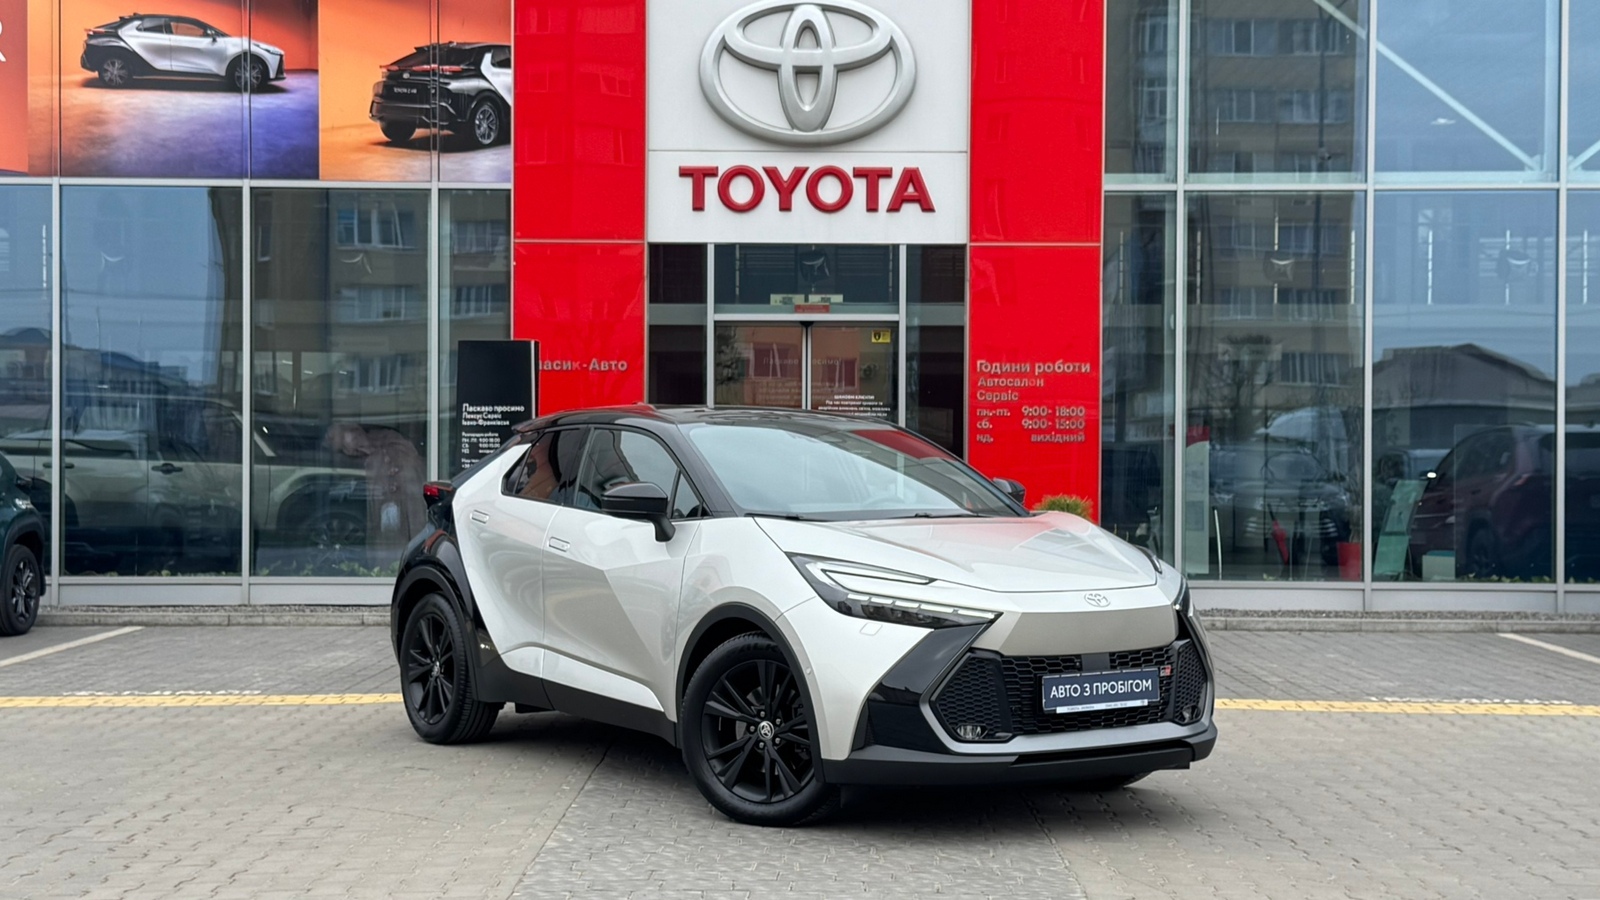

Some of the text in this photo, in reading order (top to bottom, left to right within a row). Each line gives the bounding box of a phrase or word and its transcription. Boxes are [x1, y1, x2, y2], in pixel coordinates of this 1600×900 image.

[678, 165, 936, 213] TOYOTA
[976, 360, 1091, 376] Години роботи
[977, 377, 1044, 387] Автосалон
[976, 390, 1019, 403] Сервіс
[462, 403, 525, 413] Паскаво просимо
[976, 419, 993, 429] сб.
[976, 431, 1085, 443] нд. вихідний
[1050, 683, 1081, 699] АВТО
[1093, 679, 1152, 695] ПРОБІГОМ
